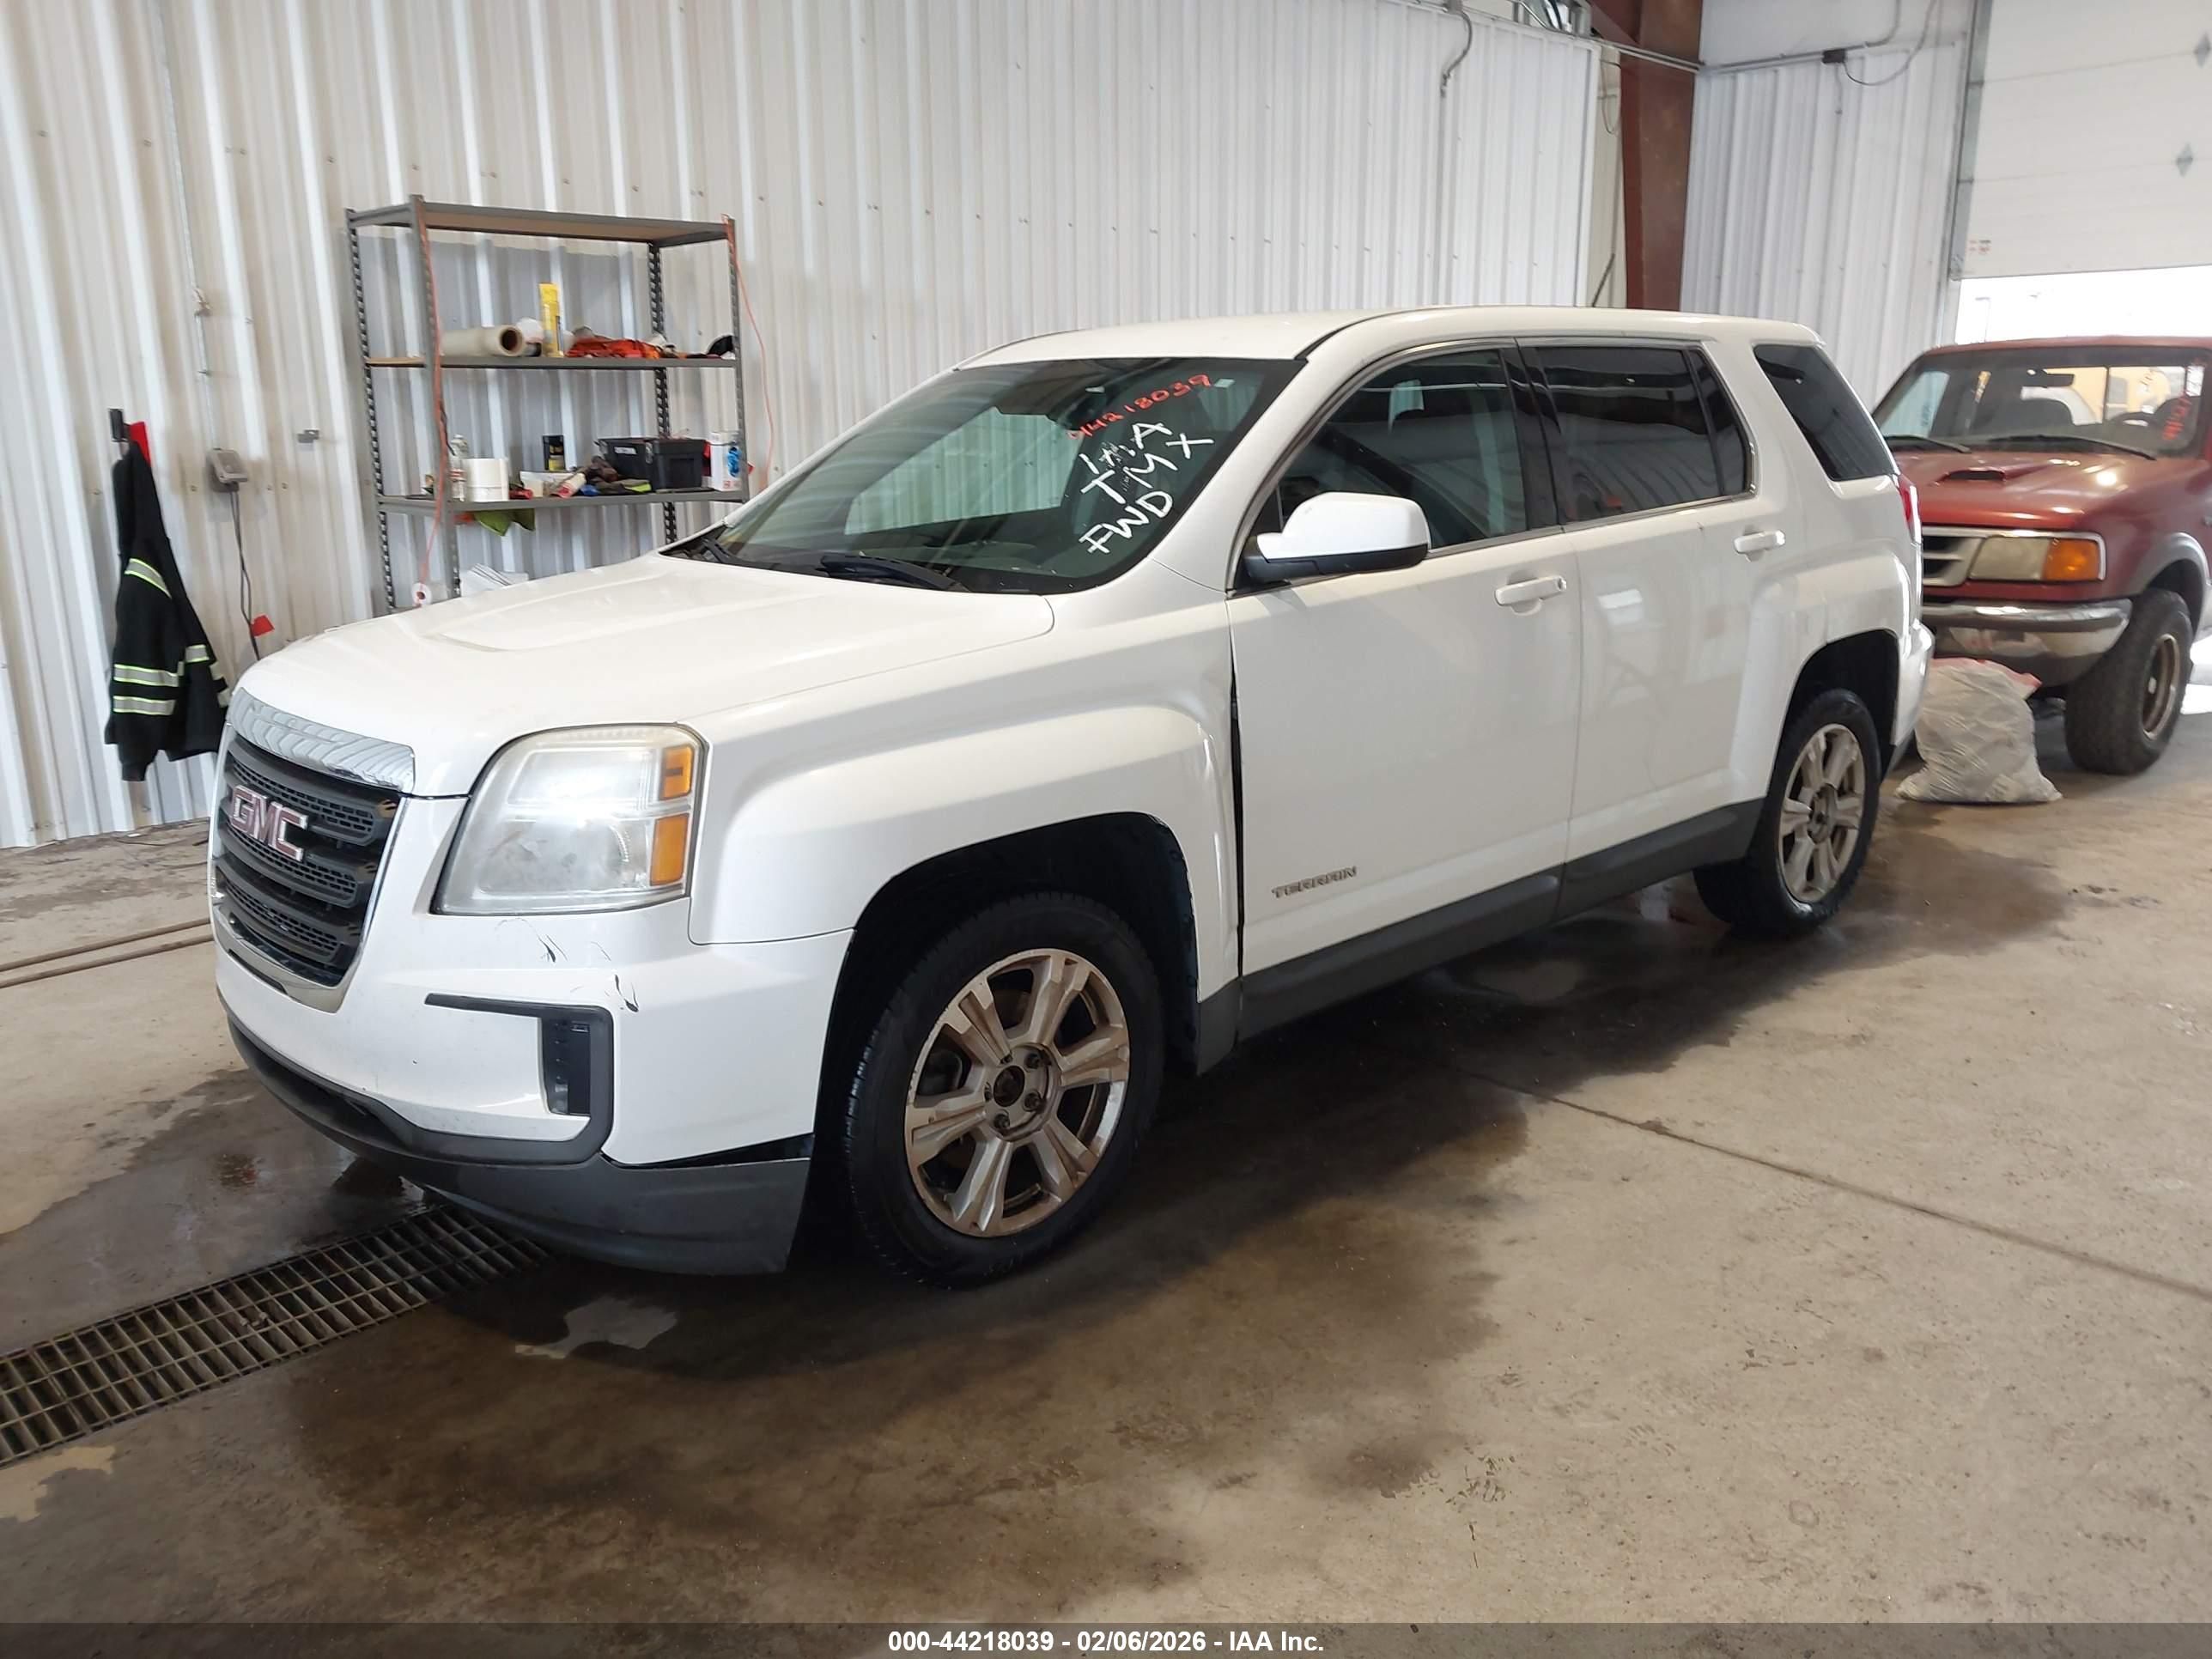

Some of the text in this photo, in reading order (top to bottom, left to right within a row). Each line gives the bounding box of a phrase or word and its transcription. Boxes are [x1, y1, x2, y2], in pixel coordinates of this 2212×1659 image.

[1079, 490, 1173, 554] FWD
[231, 785, 309, 861] GMC
[1271, 866, 1357, 898] TERRAIN
